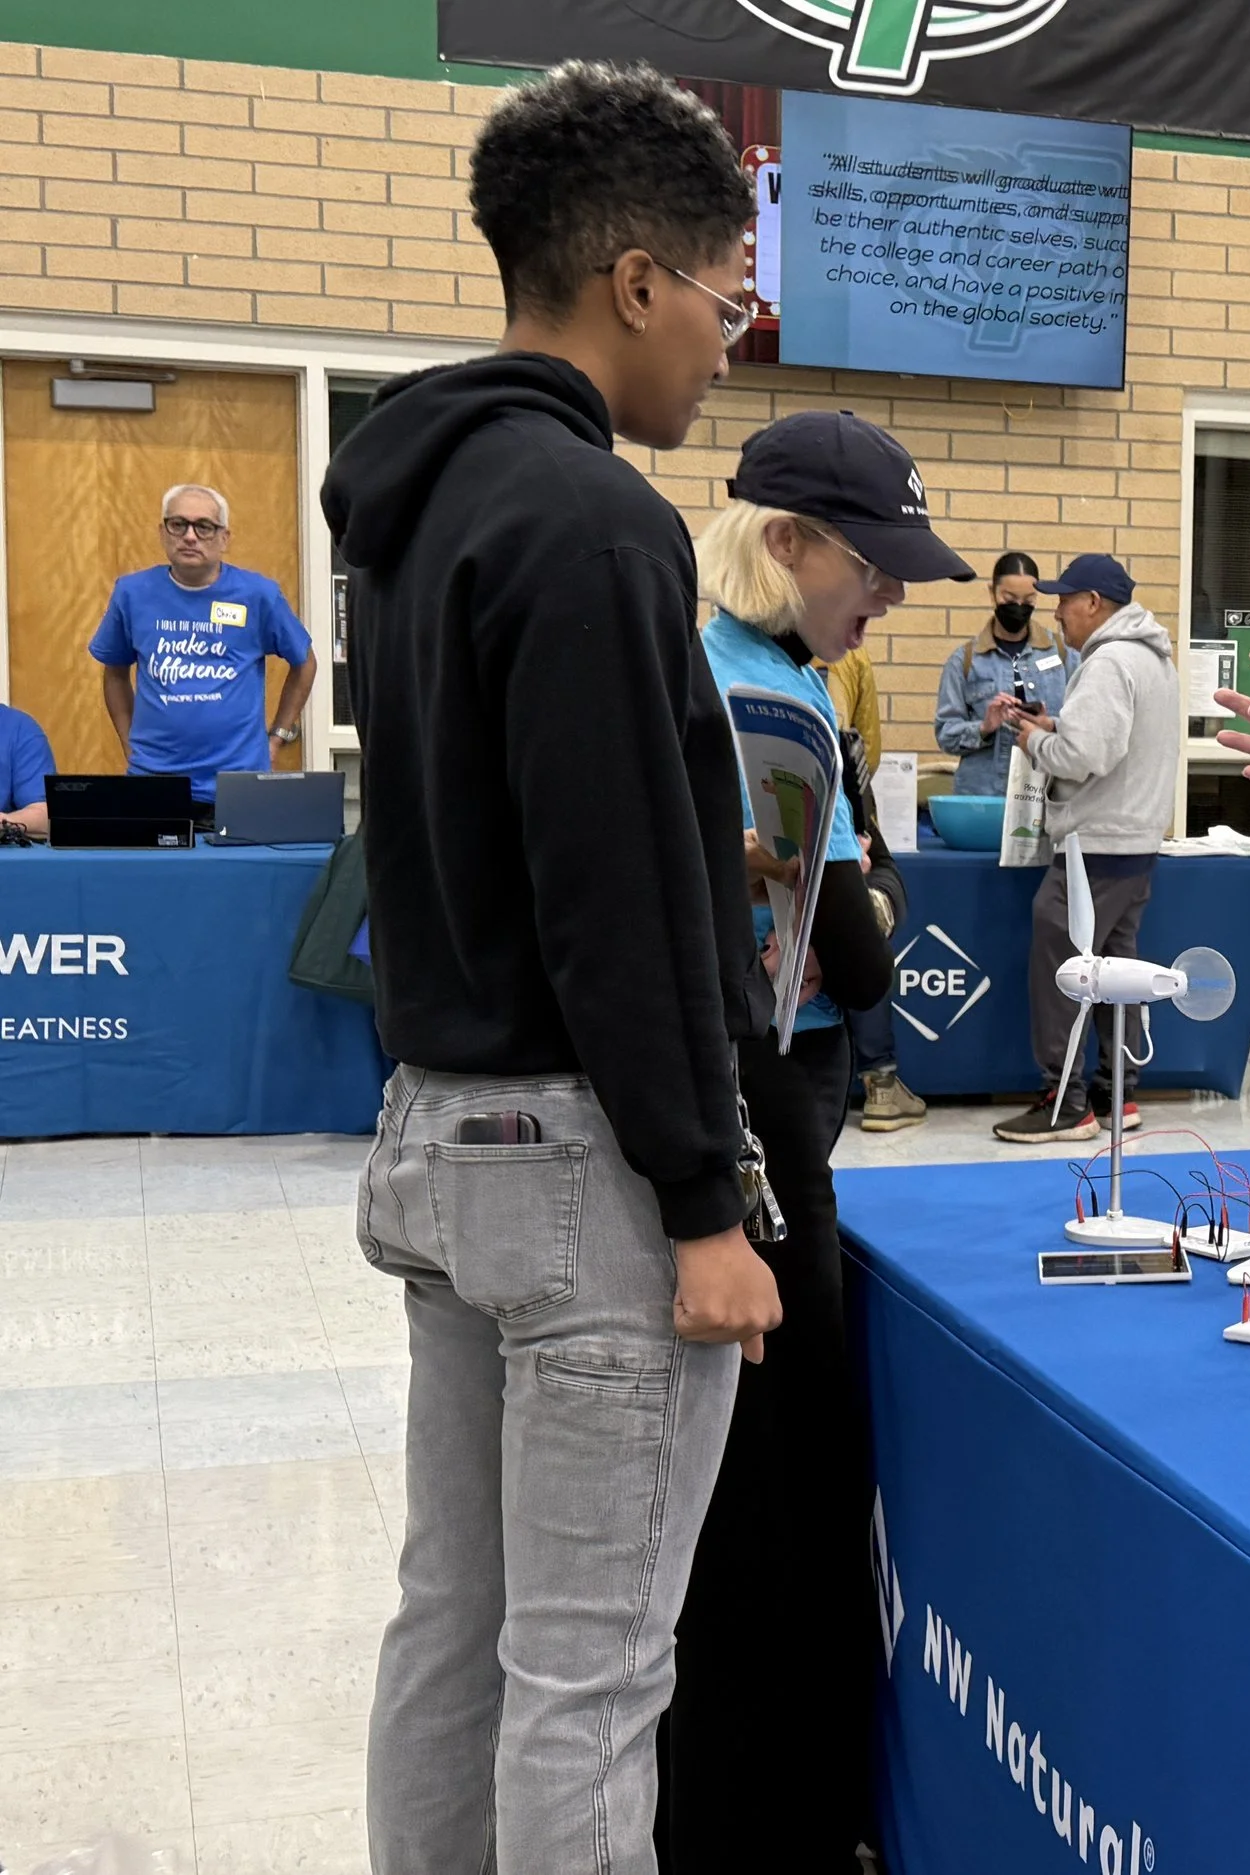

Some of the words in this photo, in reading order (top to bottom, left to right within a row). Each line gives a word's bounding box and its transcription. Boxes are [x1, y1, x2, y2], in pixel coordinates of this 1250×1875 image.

[857, 160, 960, 184] students
[961, 168, 996, 187] will
[995, 174, 1097, 196] graduate
[808, 180, 868, 203] skills,
[870, 190, 1021, 218] opportunities,
[1023, 203, 1070, 221] and
[814, 206, 843, 226] be
[848, 211, 899, 232] their
[903, 218, 1005, 242] authentic
[1010, 227, 1078, 250] selves,
[820, 236, 857, 256] the
[861, 241, 934, 267] college
[939, 249, 982, 266] and
[985, 254, 1055, 273] career
[1057, 259, 1107, 278] path
[826, 264, 899, 288] choice,
[905, 273, 948, 291] and
[952, 274, 1004, 295] have
[1008, 284, 1022, 297] a
[1025, 285, 1105, 303] positive
[890, 300, 917, 315] on
[923, 299, 958, 319] the
[962, 302, 1027, 325] global
[157, 632, 209, 655] make
[210, 641, 227, 657] a
[0, 933, 129, 976] WER
[900, 969, 967, 997] PGE
[1, 1016, 129, 1040] EATNESS
[923, 1603, 972, 1717] NW
